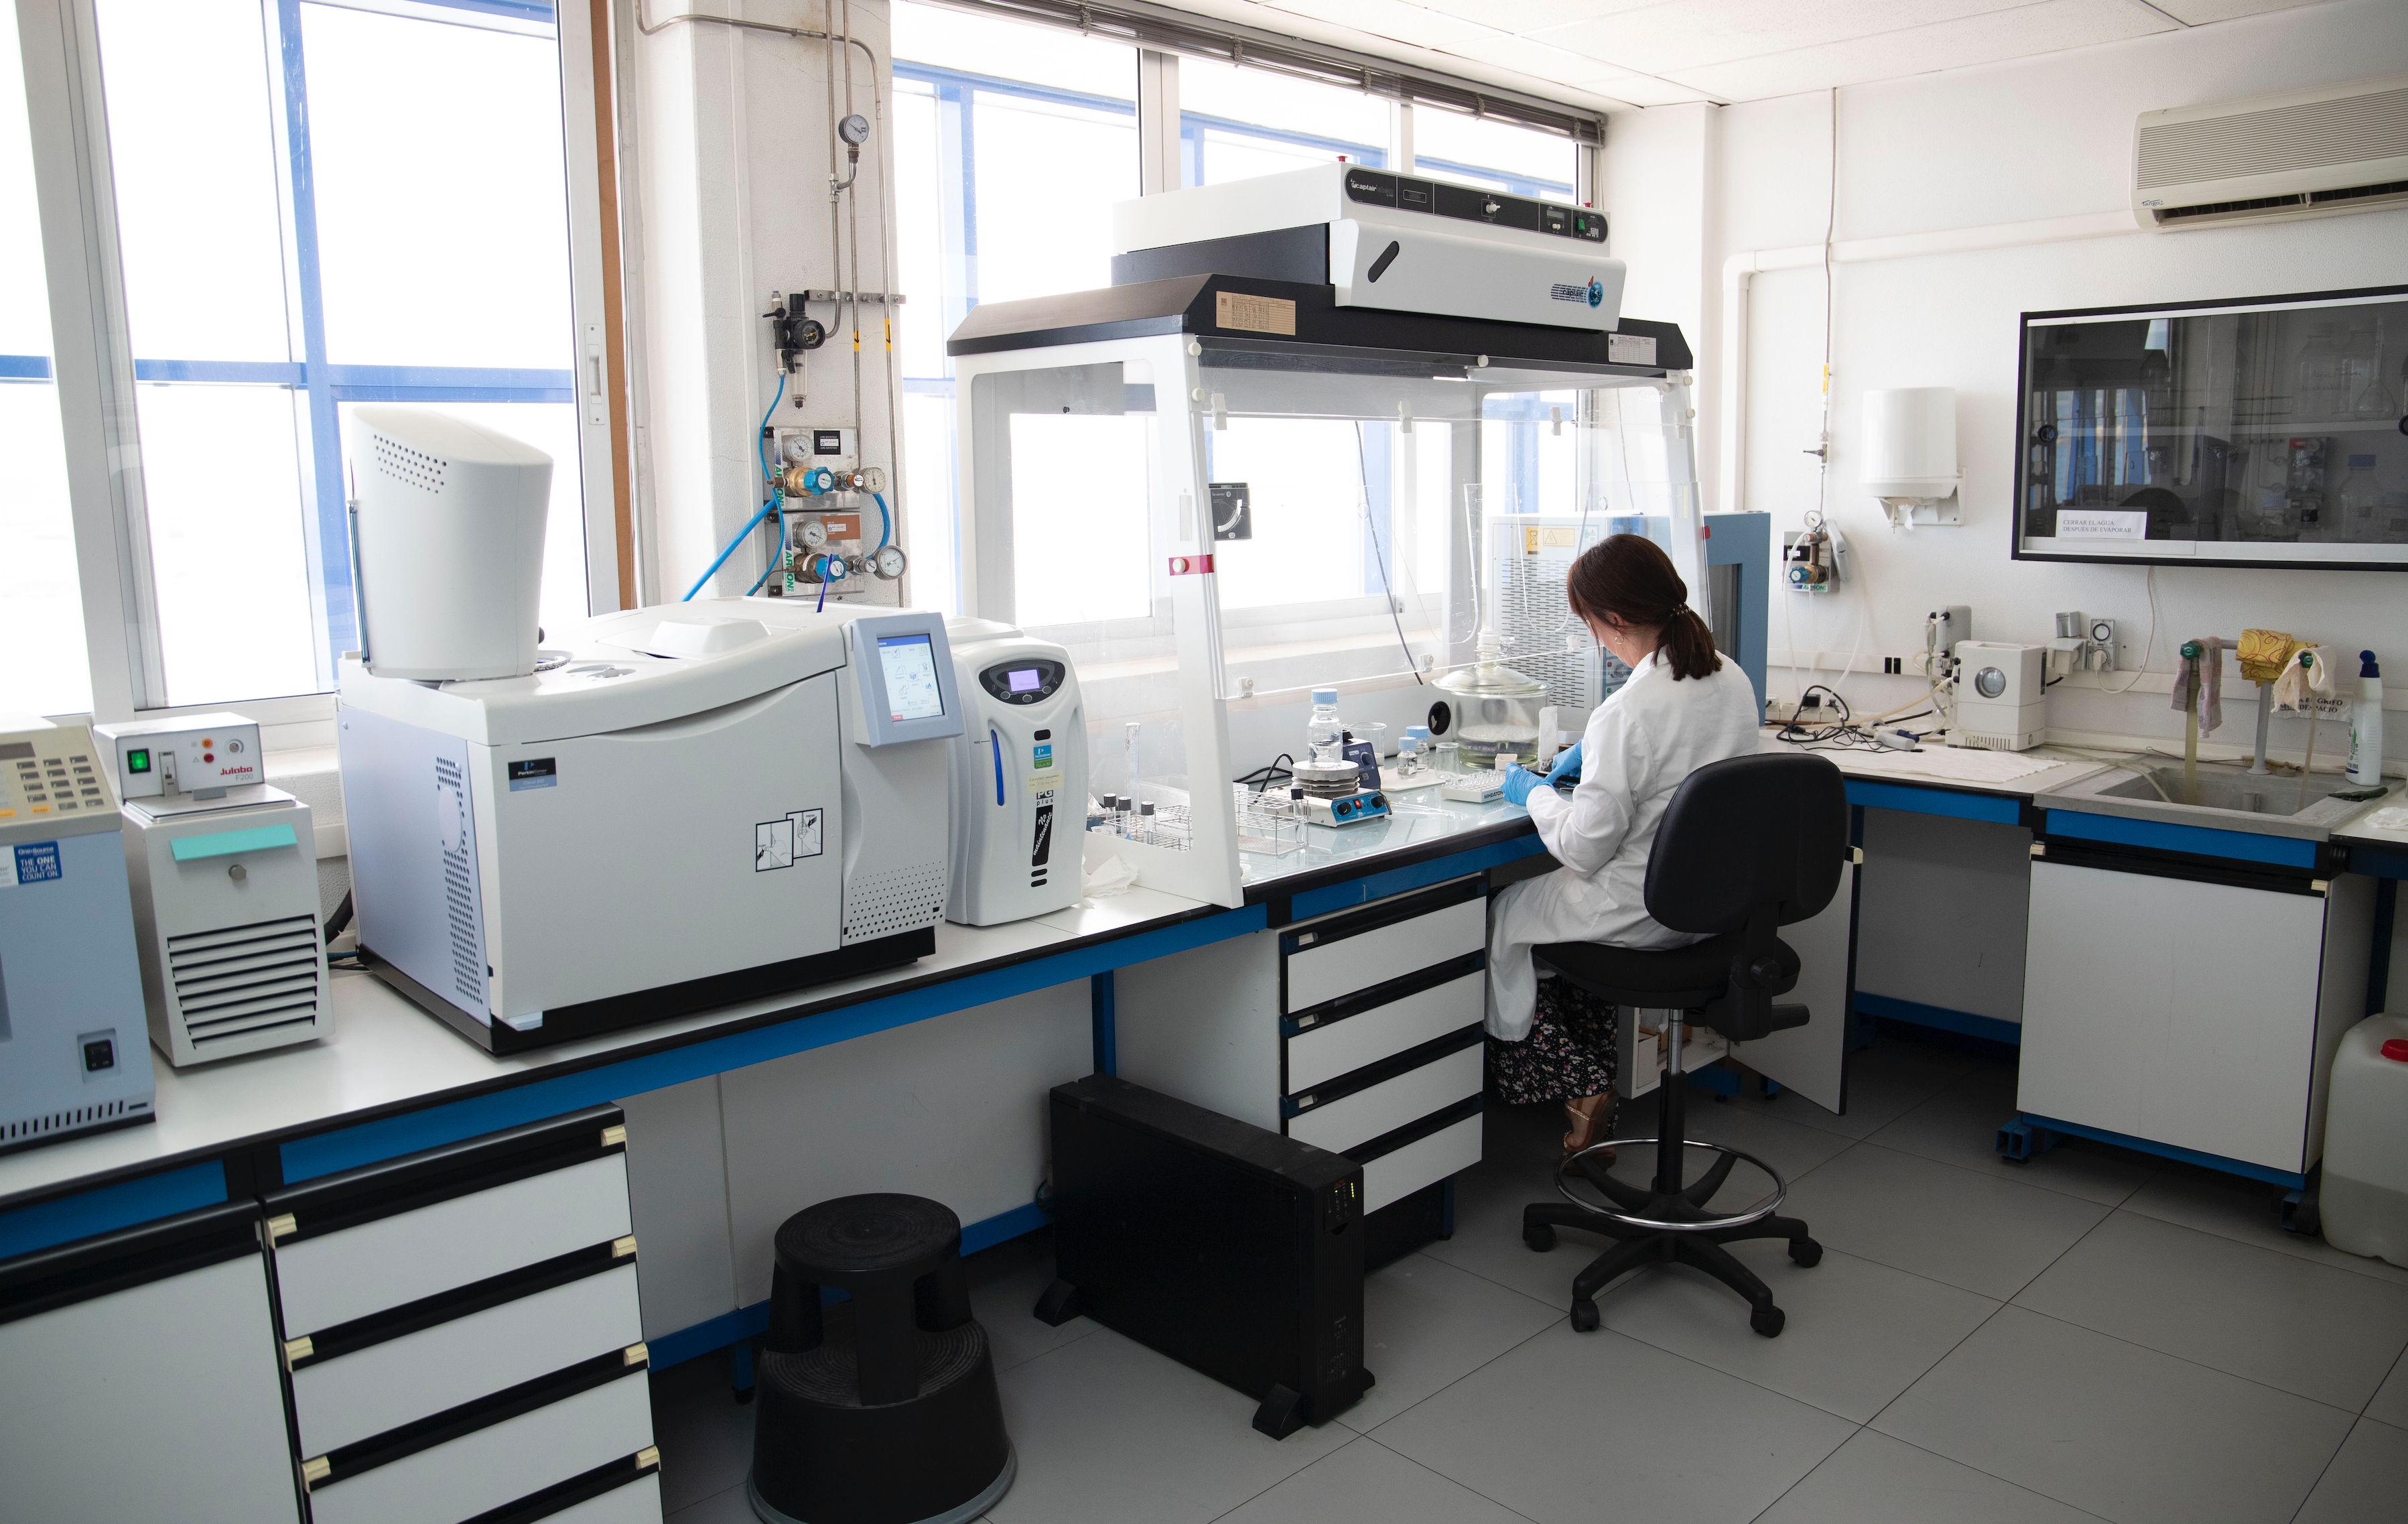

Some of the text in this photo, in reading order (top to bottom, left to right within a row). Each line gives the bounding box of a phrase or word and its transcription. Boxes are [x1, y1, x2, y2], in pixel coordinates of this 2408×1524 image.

[785, 551, 794, 588] ARON
[1036, 798, 1053, 806] plus
[1033, 812, 1052, 856] maintenance
[20, 855, 55, 867] THE ONE
[21, 863, 56, 873] YOU CAN
[22, 871, 45, 881] COUNT
